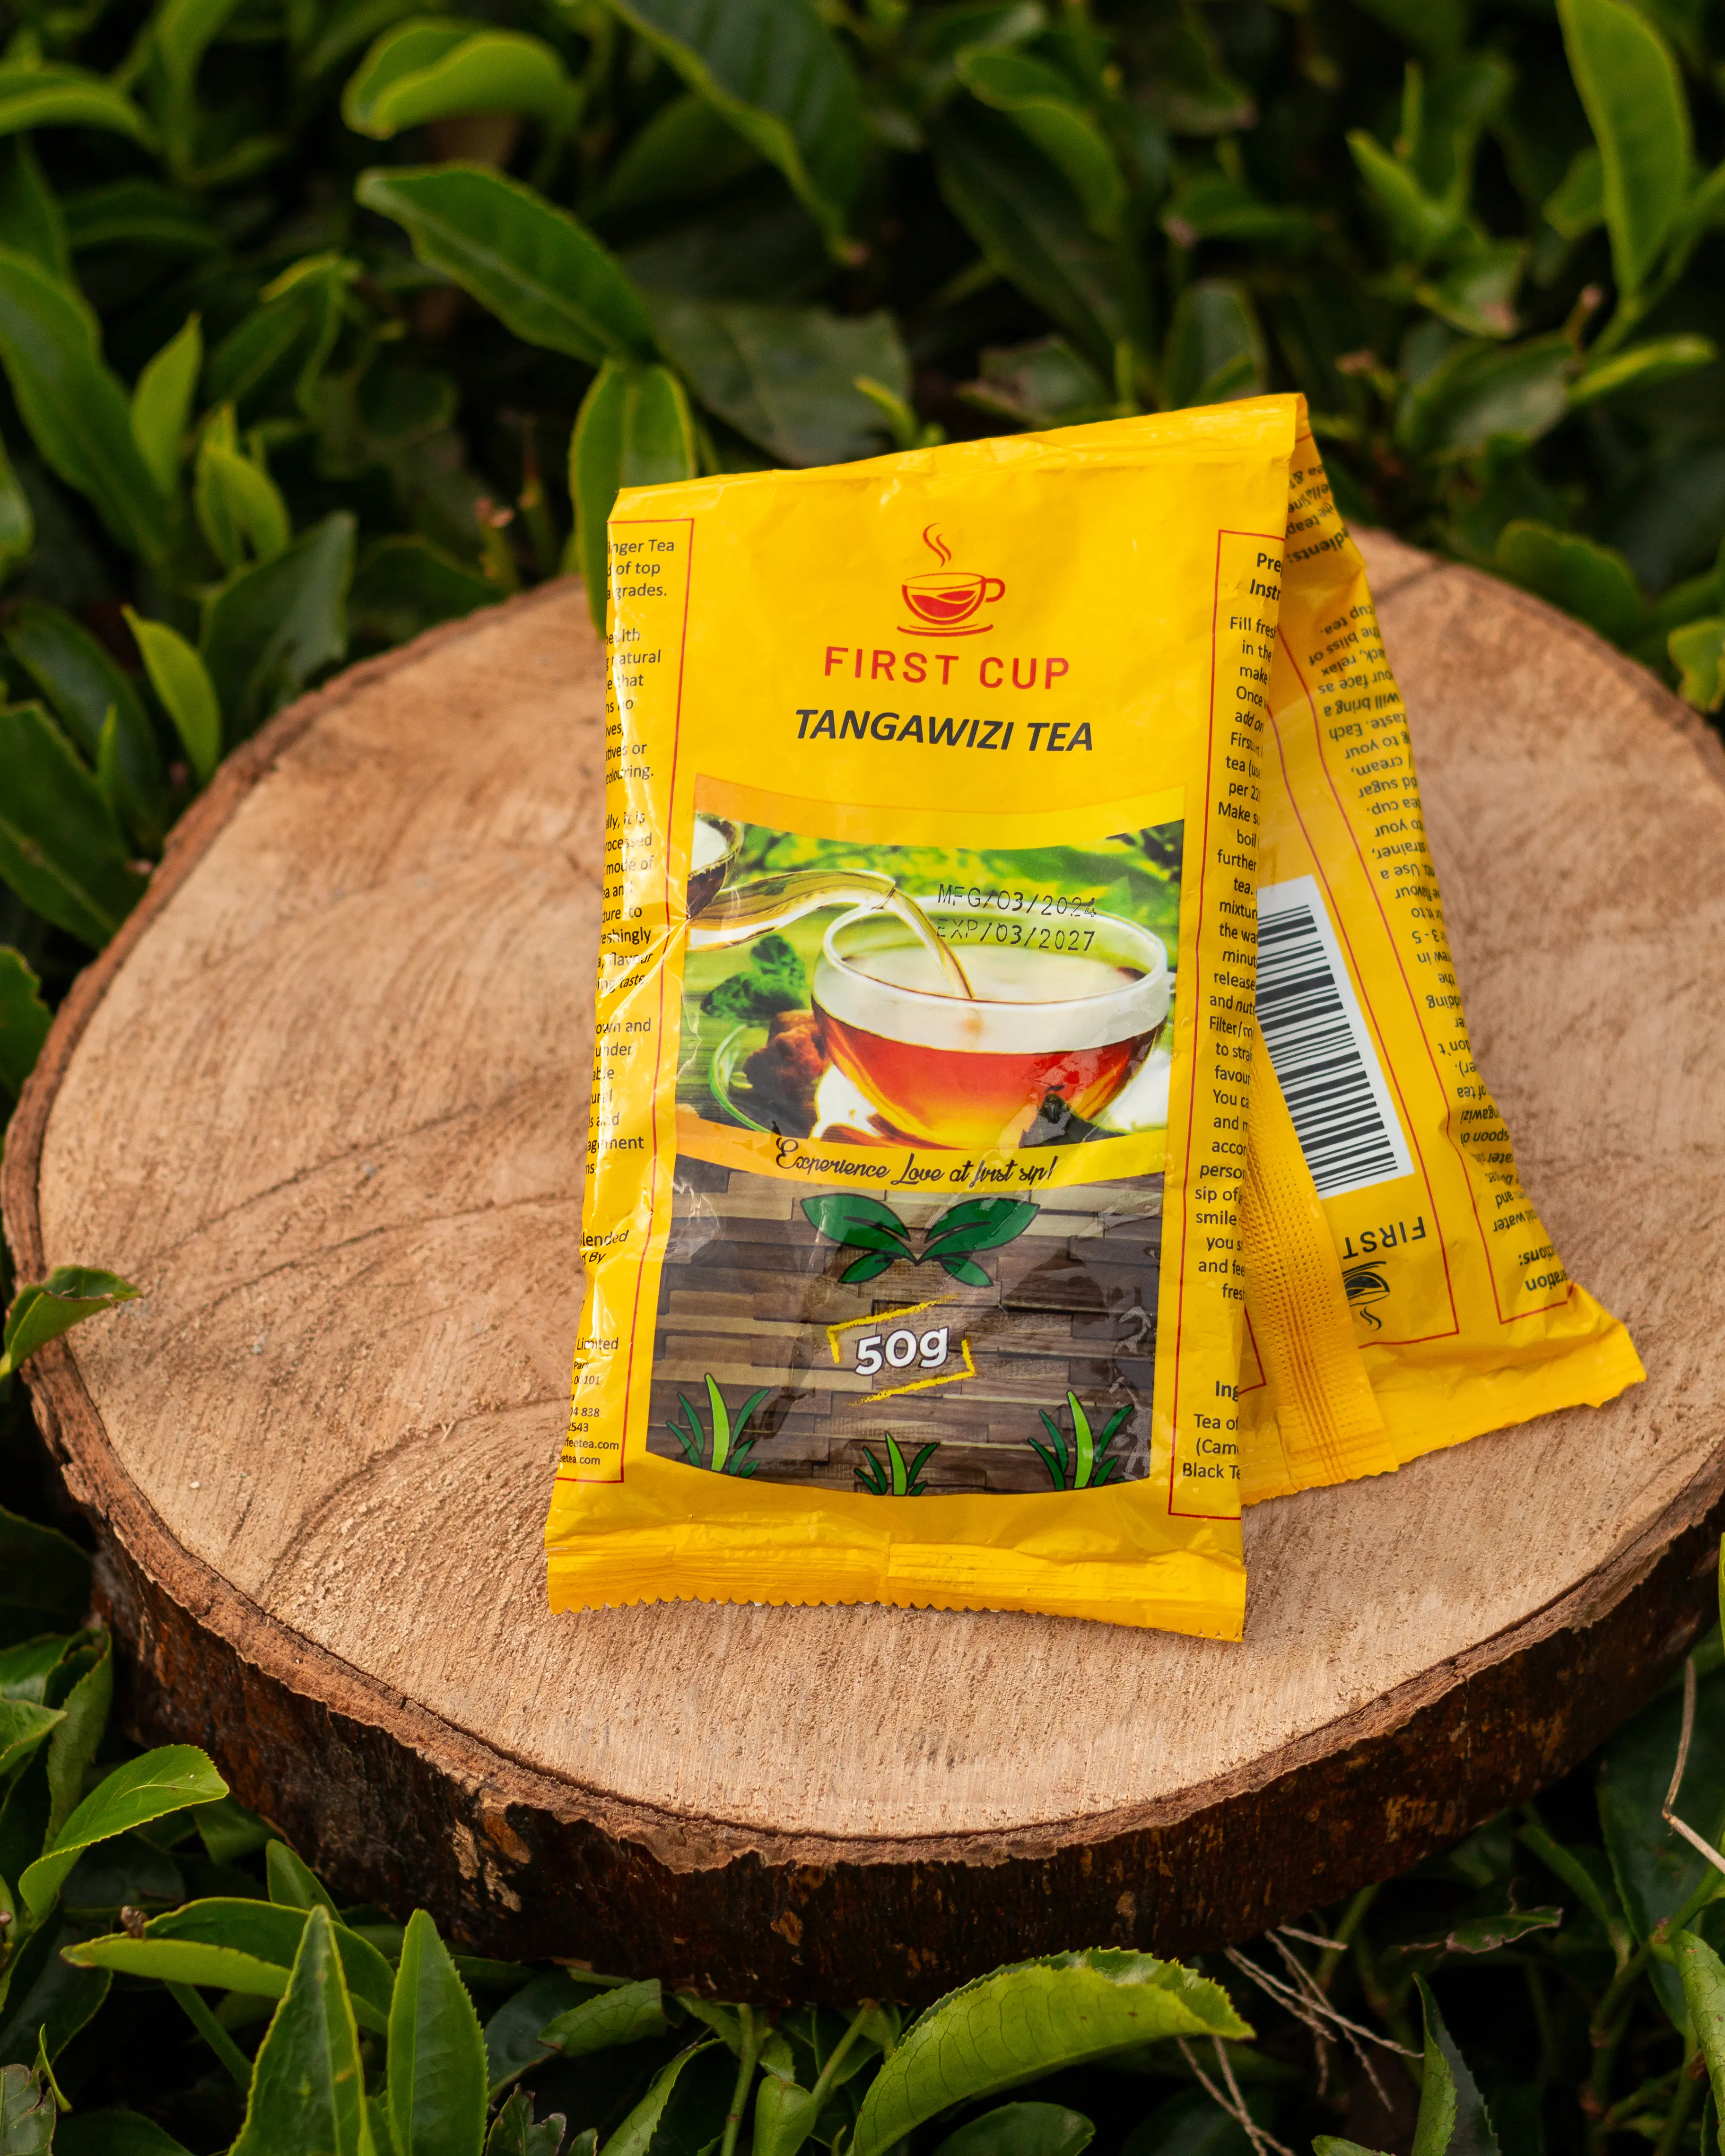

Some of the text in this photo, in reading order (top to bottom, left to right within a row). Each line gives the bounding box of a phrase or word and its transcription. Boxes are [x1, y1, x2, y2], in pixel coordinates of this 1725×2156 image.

[648, 539, 674, 551] Tea
[616, 561, 660, 577] of top
[615, 583, 667, 600] grades.
[1230, 617, 1251, 631] Fill
[1320, 617, 1347, 635] tea.
[1242, 640, 1272, 662] in the
[1326, 632, 1359, 655] bliss
[1308, 651, 1323, 666] of
[1321, 654, 1357, 676] relax
[824, 646, 1070, 689] FIRST CUP
[1240, 666, 1268, 685] make
[1318, 683, 1334, 694] as
[1339, 675, 1368, 689] face
[1236, 686, 1263, 707] Once
[1324, 692, 1400, 717] will bring a
[1235, 711, 1255, 728] add
[795, 709, 1093, 751] TANGAWIZI TEA
[1329, 723, 1363, 742] Each
[632, 744, 647, 755] or
[1231, 731, 1253, 751] First
[1345, 736, 1399, 759] to your
[1226, 756, 1245, 772] tea
[1351, 756, 1403, 776] cream,
[1229, 782, 1260, 803] per 22
[1358, 780, 1398, 799] sugar
[1218, 801, 1251, 822] Make
[1367, 801, 1399, 815] cup.
[1375, 818, 1408, 837] your
[1237, 829, 1256, 849] boil
[1372, 842, 1425, 860] strainer,
[641, 855, 654, 869] of
[1217, 849, 1257, 872] further
[1380, 864, 1420, 879] Use a
[1234, 877, 1253, 895] tea.
[938, 883, 1097, 917] MFG/03/2024
[629, 907, 642, 918] to
[1411, 908, 1424, 919] to
[937, 918, 1096, 951] EXP/03/2027
[1219, 922, 1237, 940] the
[1412, 931, 1421, 944] 5
[1431, 929, 1439, 942] 3
[1417, 952, 1431, 965] in
[1214, 972, 1255, 991] release
[1210, 995, 1233, 1010] and
[595, 1017, 651, 1034] own and
[596, 1042, 633, 1057] under
[1215, 1042, 1229, 1056] to
[591, 1088, 612, 1104] ural
[1212, 1089, 1237, 1106] You
[1457, 1086, 1486, 1100] of tea
[1213, 1116, 1239, 1130] and
[1473, 1128, 1509, 1144] spoon
[776, 1137, 1057, 1188] Experience Love at first sip!
[1488, 1153, 1513, 1165] ater
[1195, 1186, 1239, 1204] sip of
[1495, 1191, 1514, 1210] and
[1196, 1210, 1237, 1226] smile
[1493, 1212, 1525, 1233] water
[580, 1230, 629, 1246] lended
[1206, 1237, 1234, 1252] you
[1343, 1216, 1426, 1260] FIRST
[589, 1252, 606, 1264] By
[1198, 1259, 1228, 1274] and
[577, 1337, 619, 1350] Limited
[855, 1326, 950, 1376] 50g
[1215, 1380, 1238, 1402] Ing
[581, 1408, 600, 1417] 838
[1194, 1413, 1220, 1429] Tea
[1196, 1437, 1239, 1456] (Cam
[1183, 1462, 1224, 1478] Black
